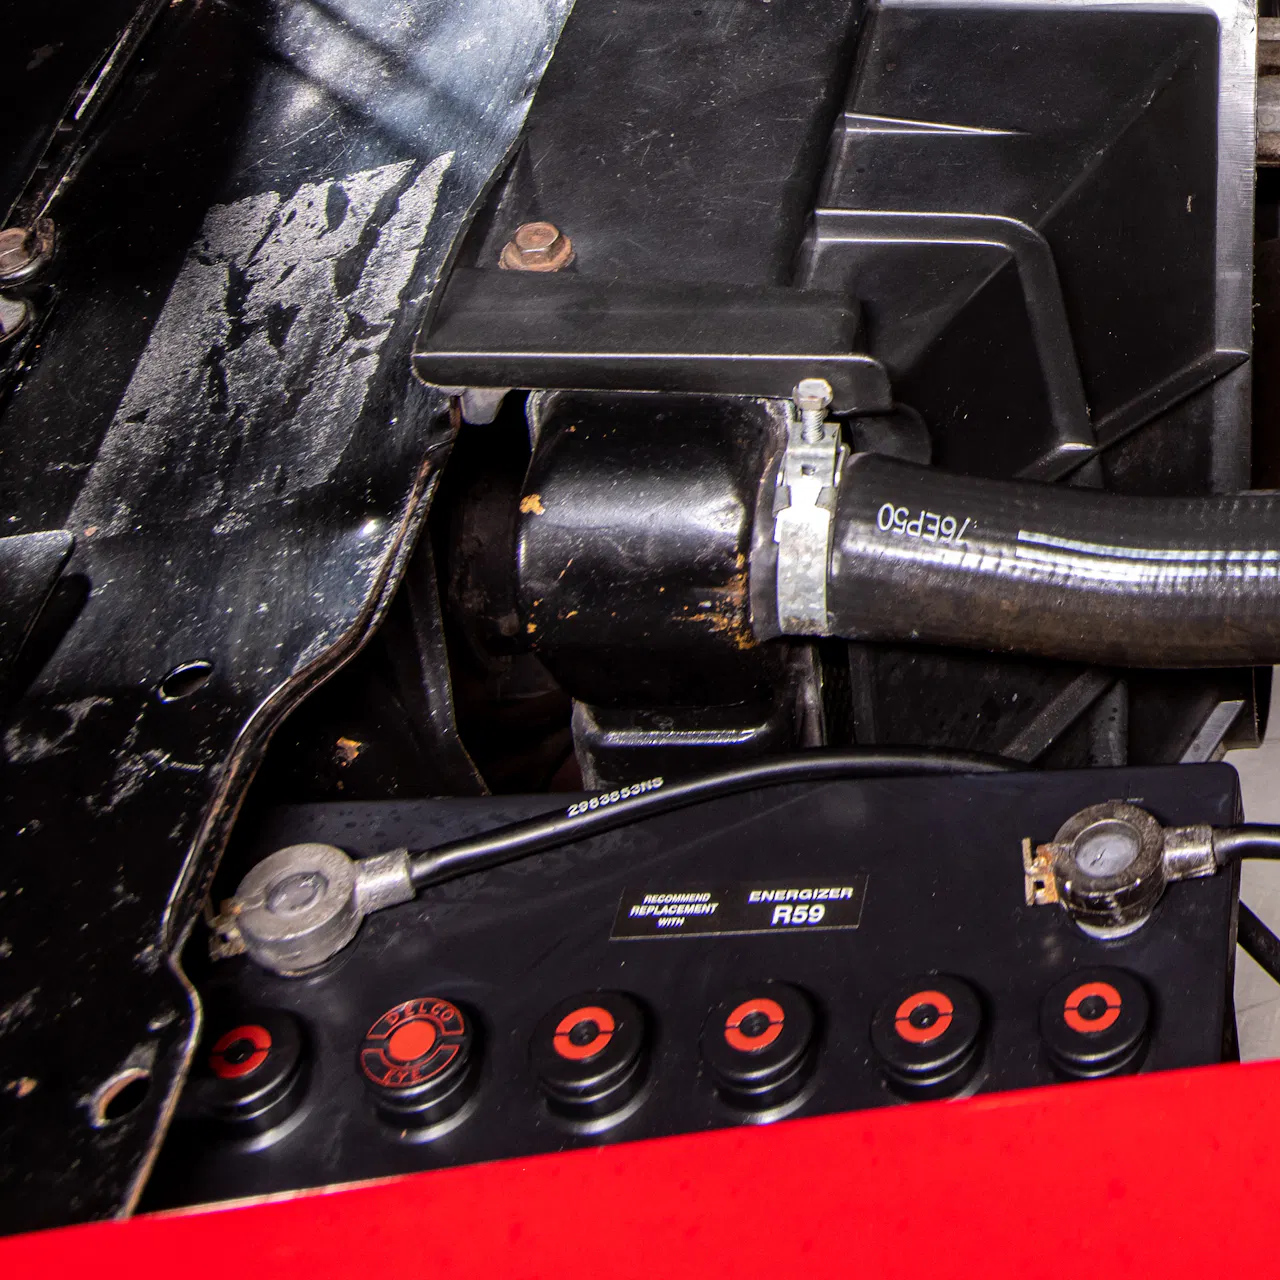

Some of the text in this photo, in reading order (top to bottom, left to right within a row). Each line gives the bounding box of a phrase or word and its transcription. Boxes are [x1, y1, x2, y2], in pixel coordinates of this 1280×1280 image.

[875, 502, 972, 544] 76EP50
[643, 892, 711, 904] RECOMMEND
[748, 887, 854, 904] ENERGIZER
[629, 902, 719, 917] REPLACEMENT
[771, 904, 826, 927] R59
[656, 916, 685, 928] WITH
[385, 1001, 456, 1025] DELCO
